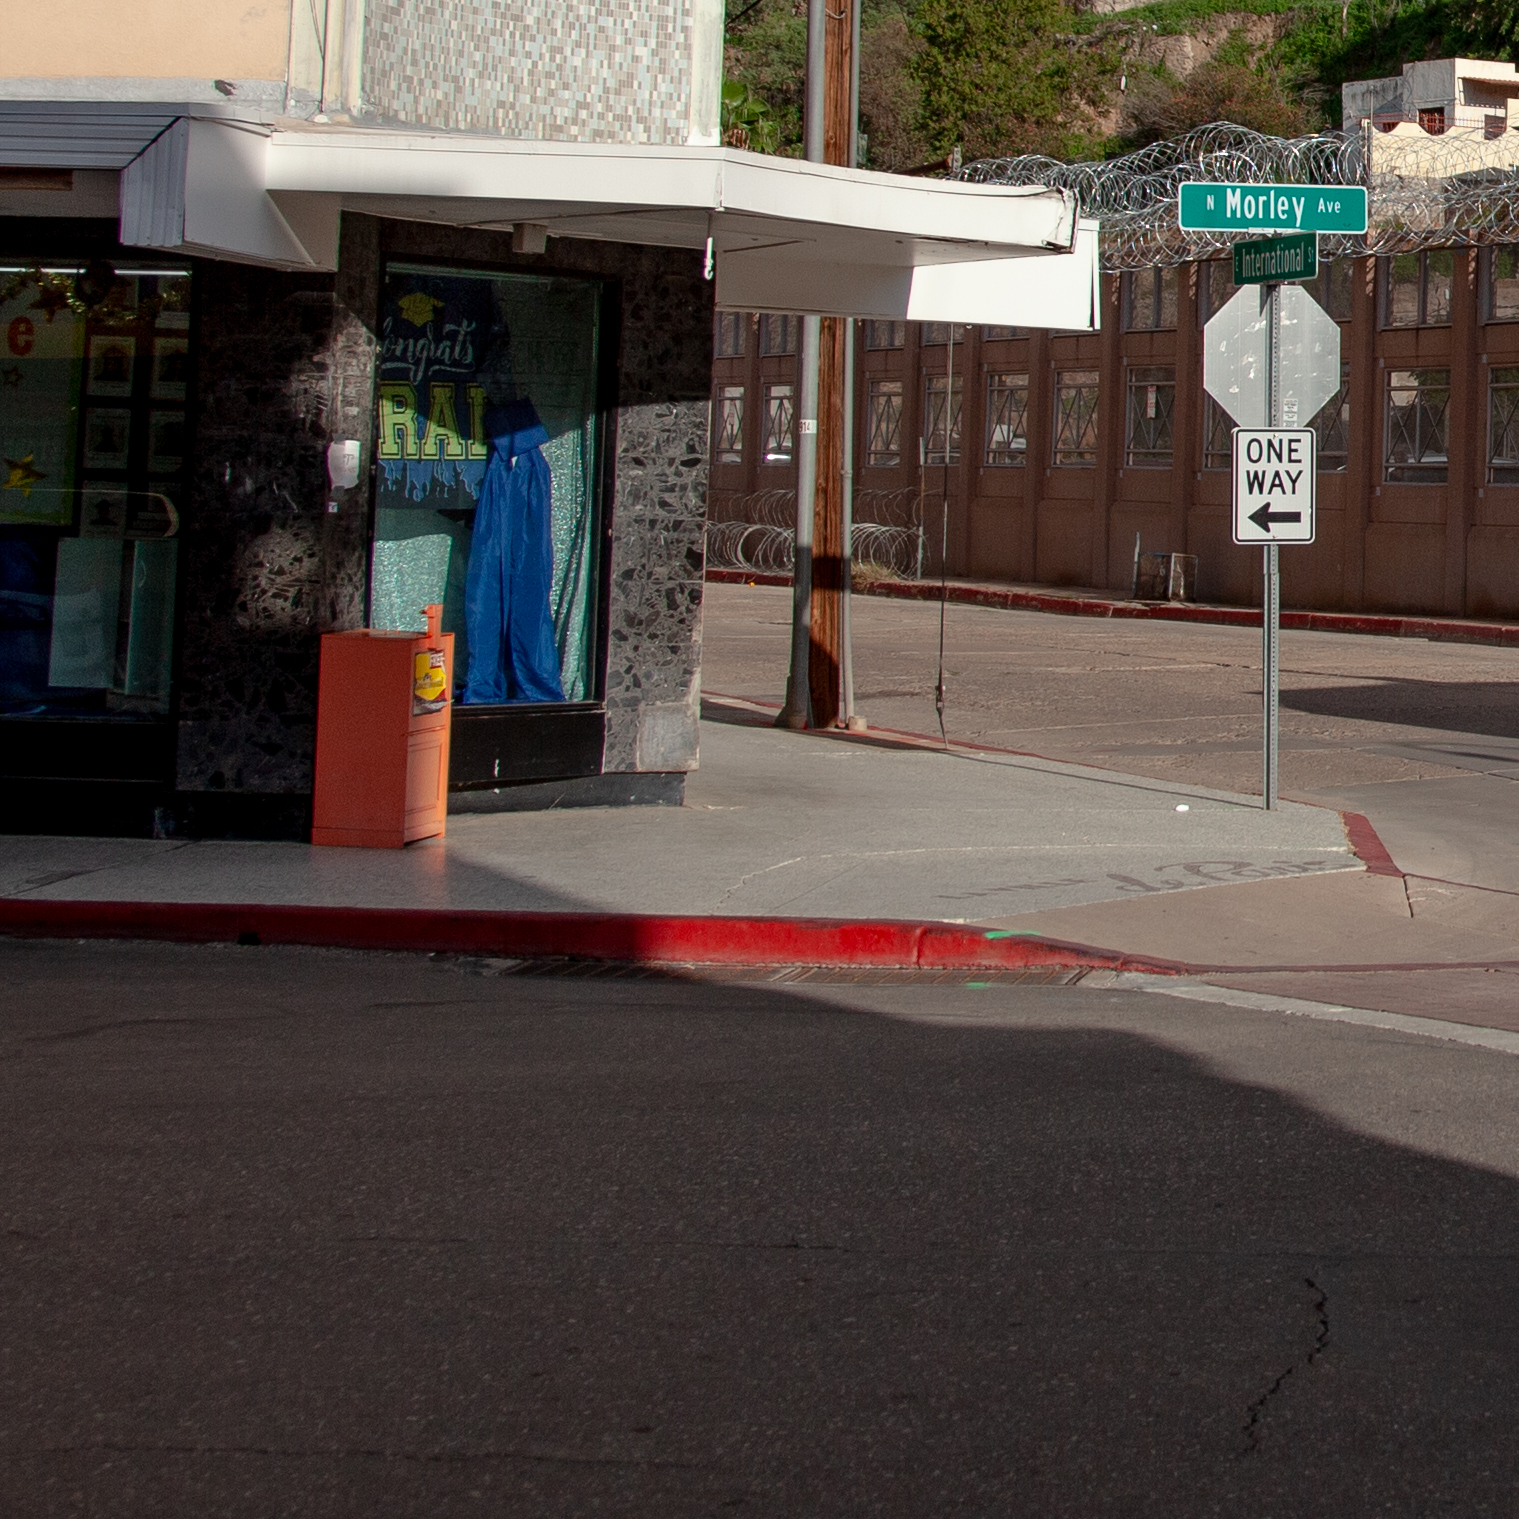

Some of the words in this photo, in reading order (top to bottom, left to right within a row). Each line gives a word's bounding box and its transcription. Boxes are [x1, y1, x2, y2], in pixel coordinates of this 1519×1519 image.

[1206, 194, 1215, 211] N
[1225, 187, 1305, 228] Morley
[1317, 197, 1341, 214] Ave
[1241, 241, 1305, 278] International
[1307, 246, 1315, 263] St
[1246, 437, 1303, 464] ONE
[1245, 469, 1304, 495] WAY
[1152, 860, 1358, 882] Paris
